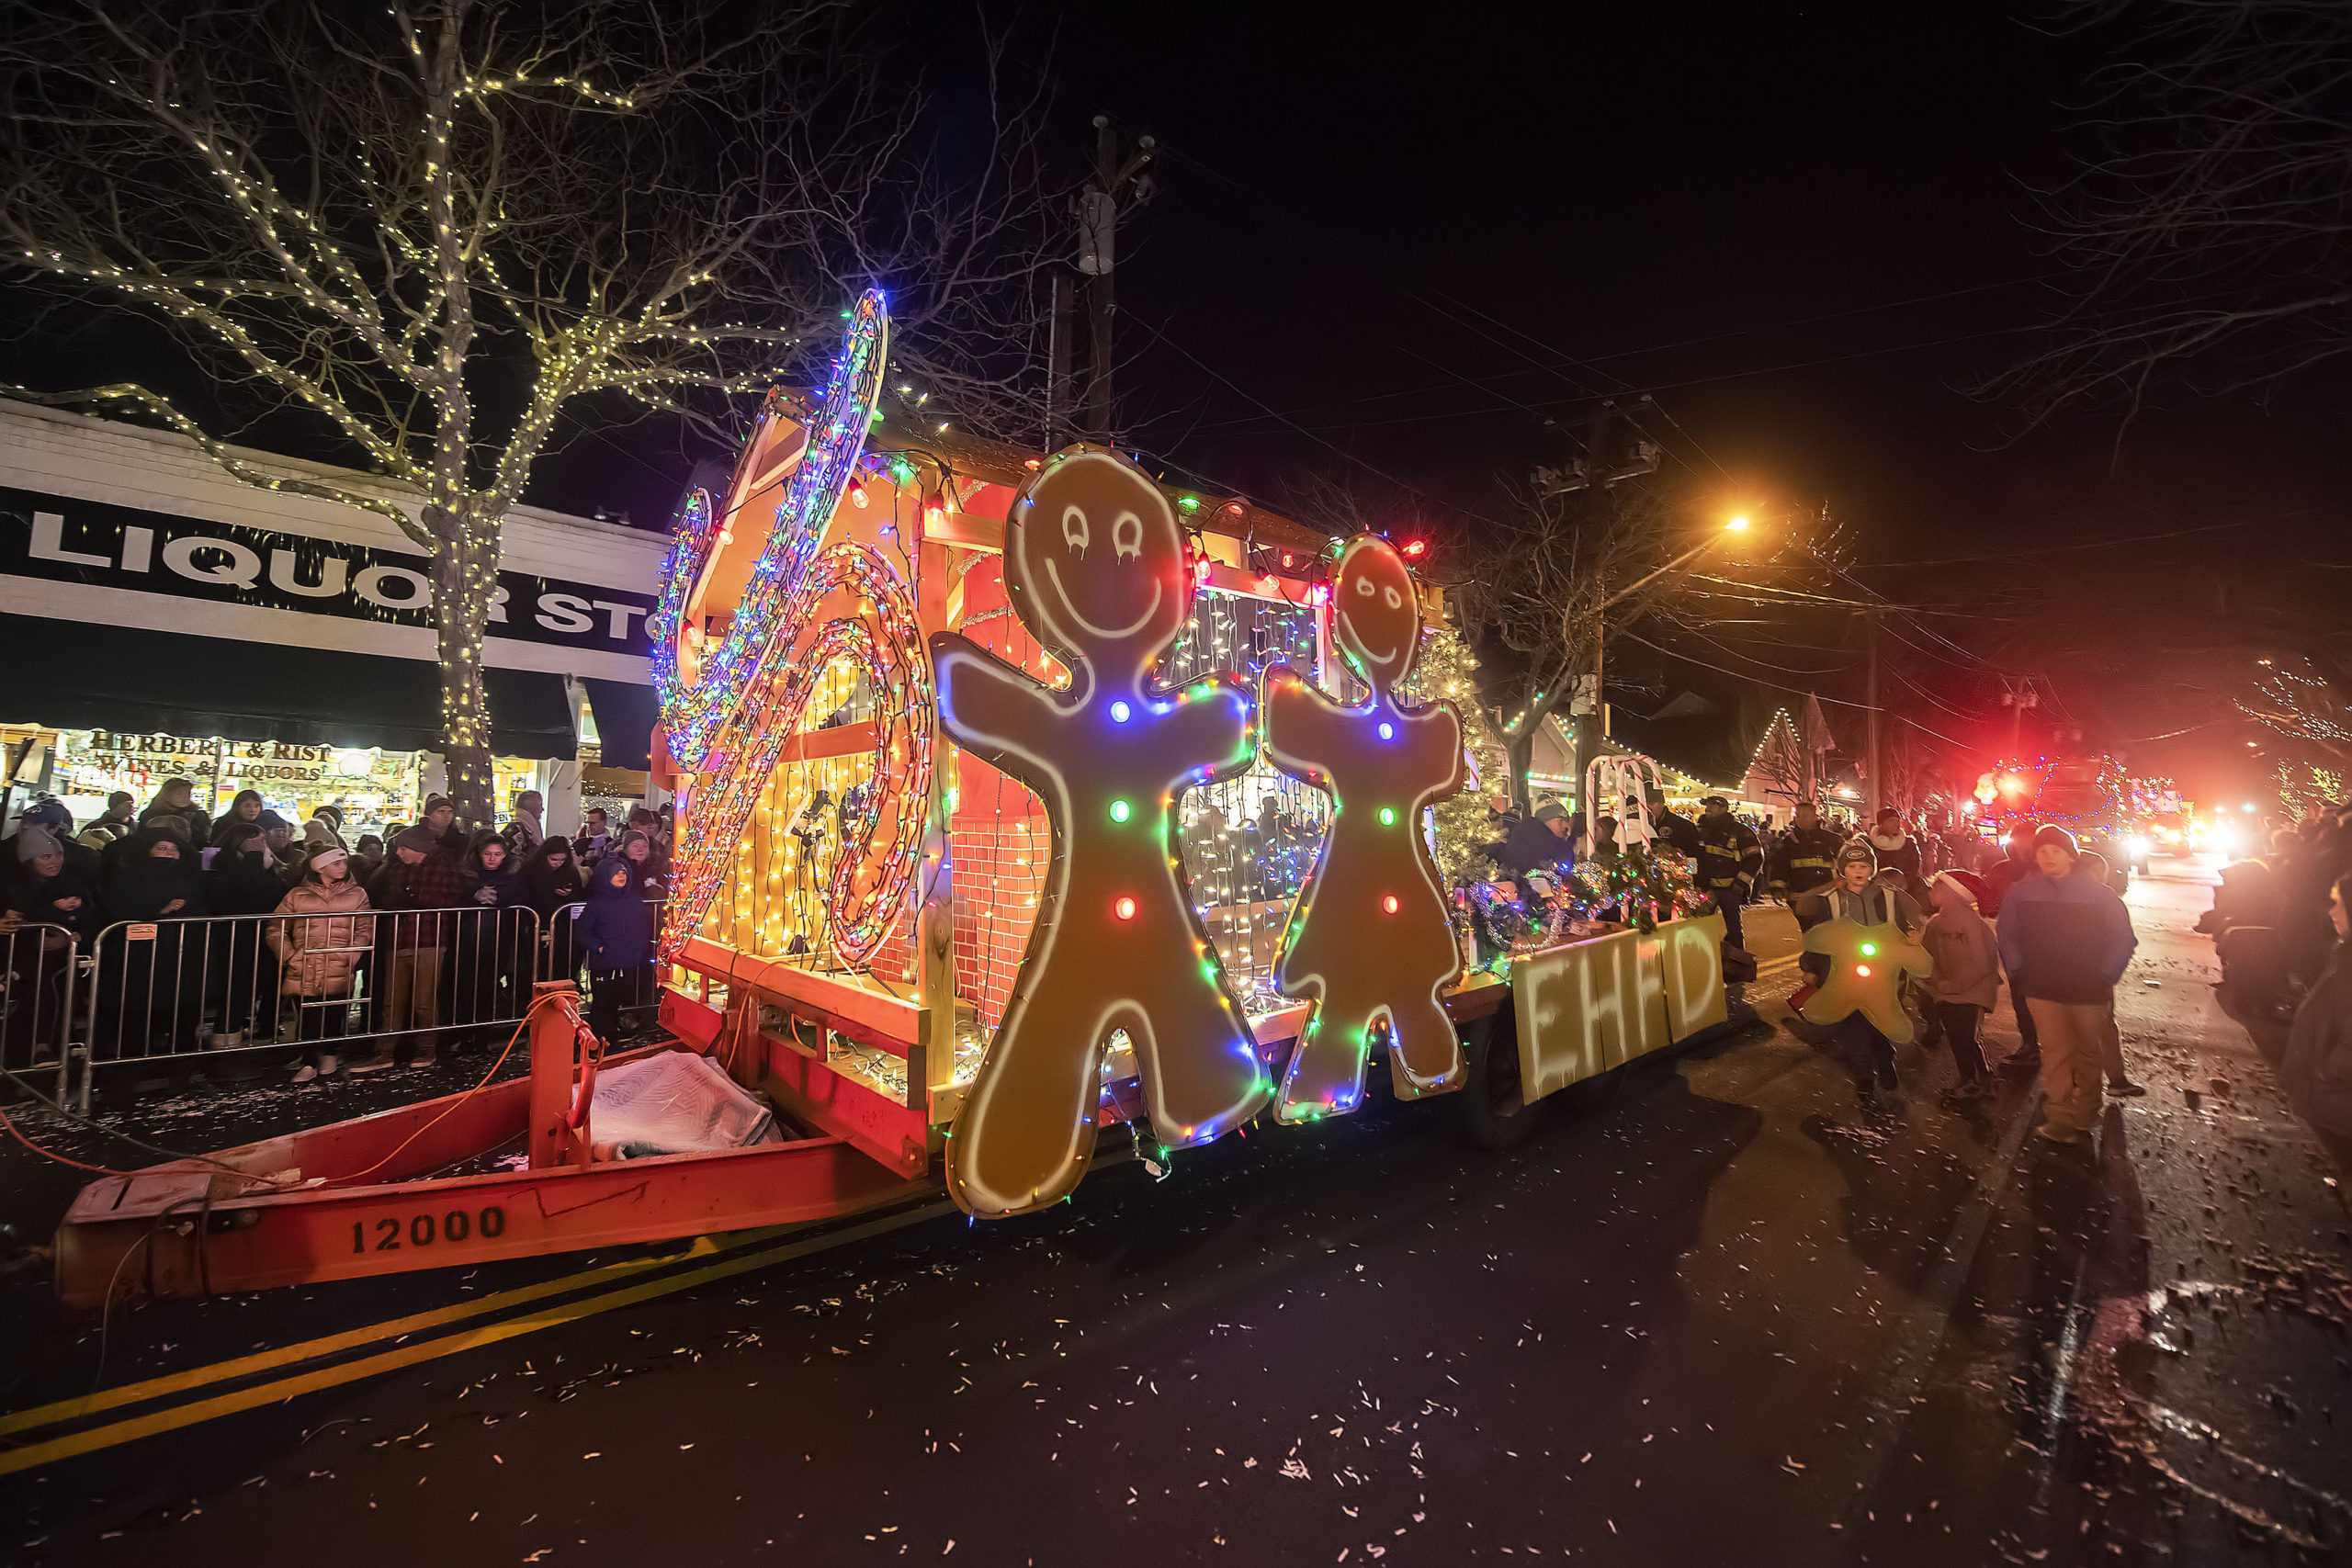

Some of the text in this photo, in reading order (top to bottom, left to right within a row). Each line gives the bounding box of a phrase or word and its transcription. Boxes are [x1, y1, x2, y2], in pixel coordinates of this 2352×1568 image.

[90, 730, 331, 761] HERBERT & RIST
[96, 754, 322, 781] WINES & LIQUORS
[1525, 926, 1716, 1095] EHFD
[353, 1206, 504, 1254] 12000
